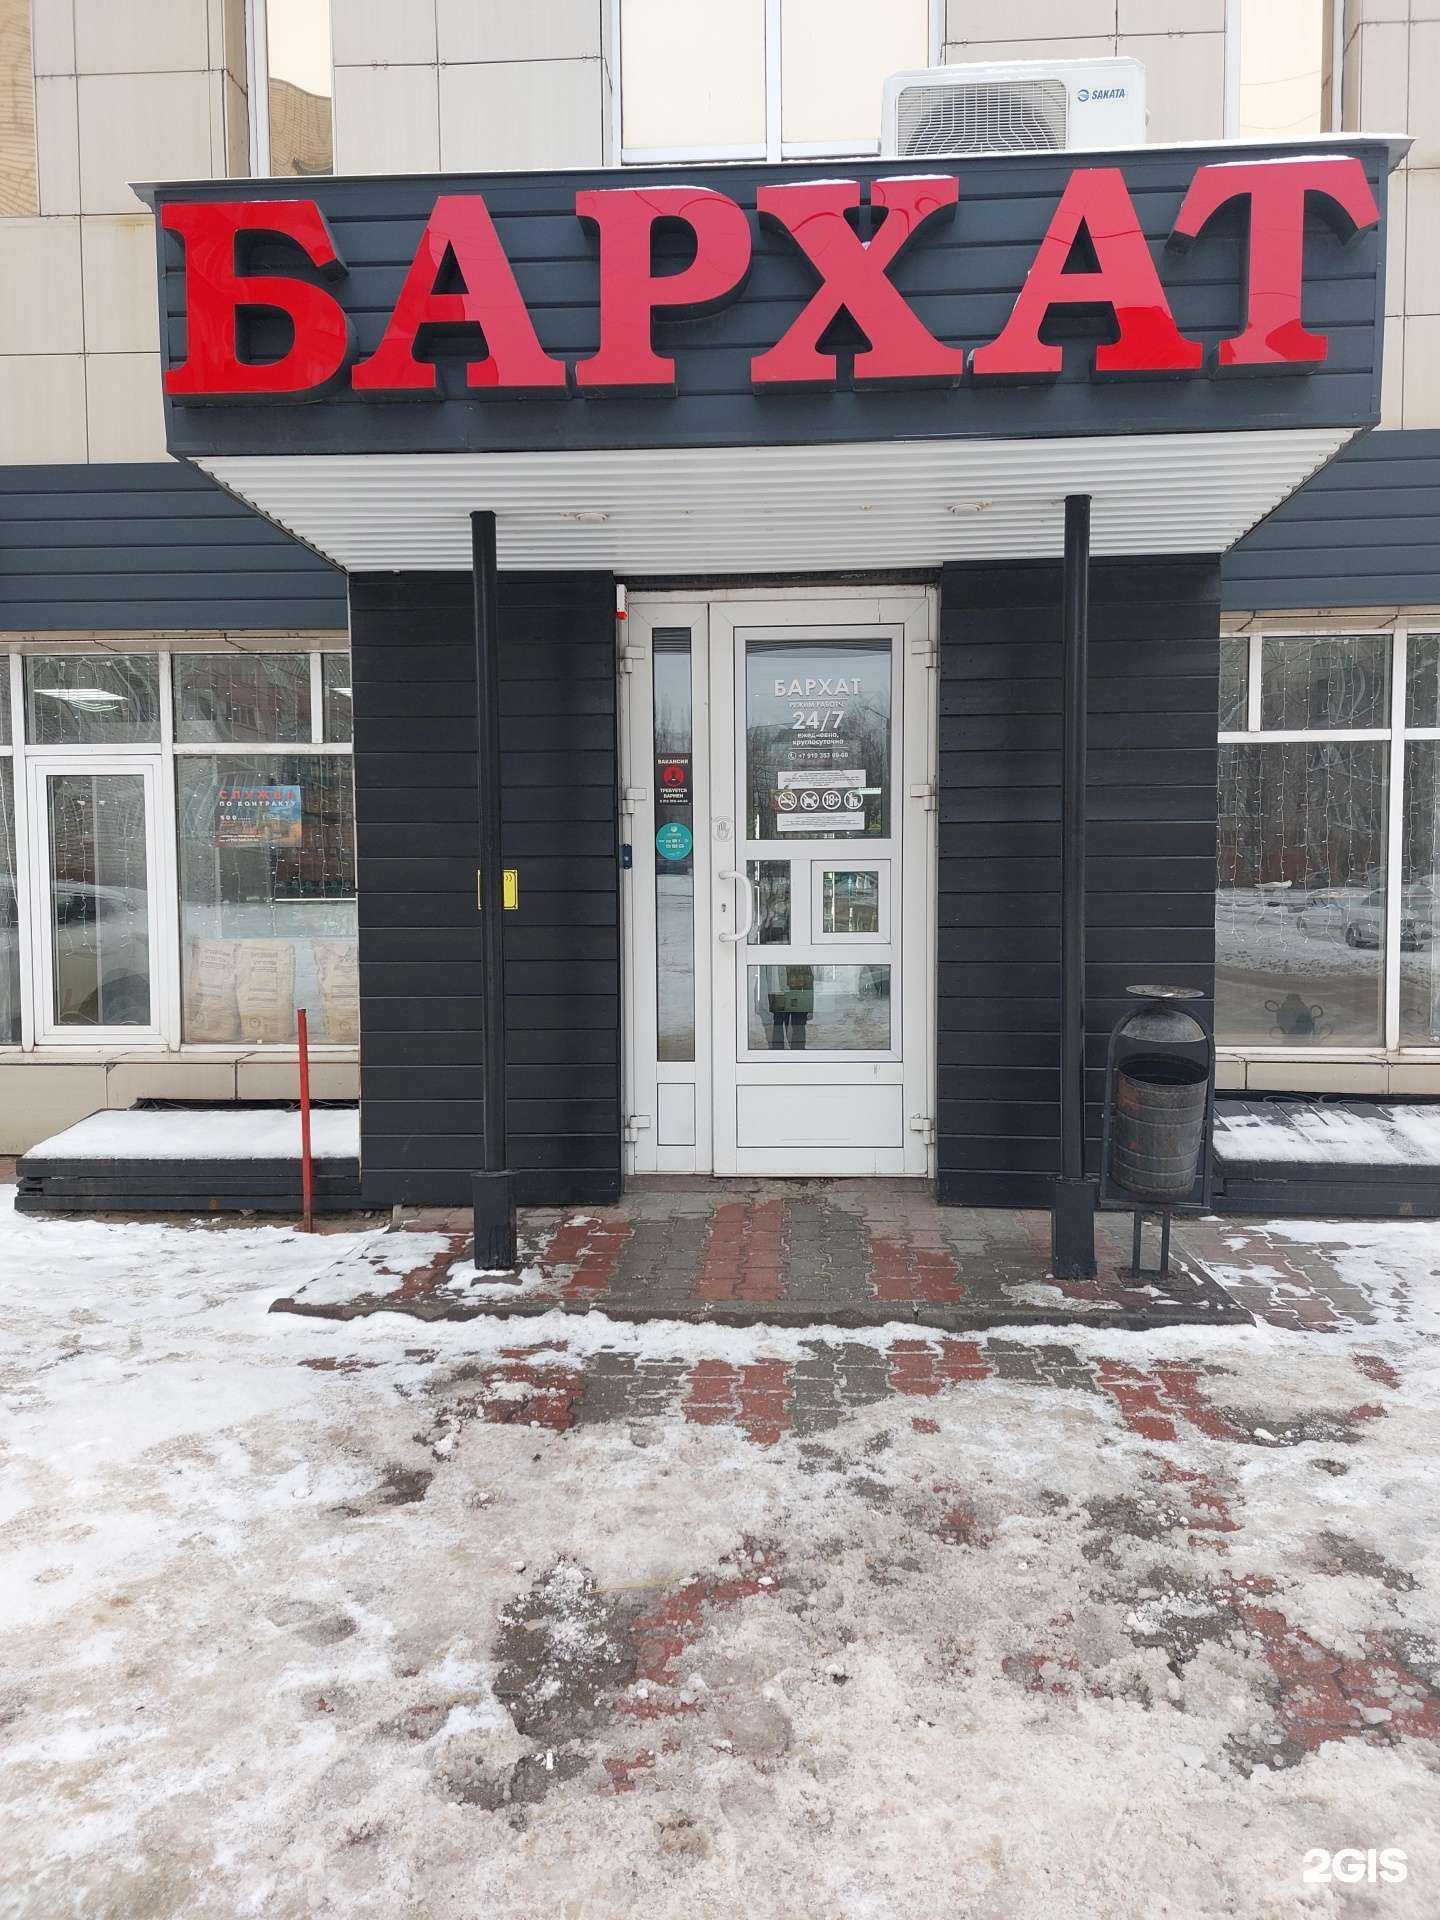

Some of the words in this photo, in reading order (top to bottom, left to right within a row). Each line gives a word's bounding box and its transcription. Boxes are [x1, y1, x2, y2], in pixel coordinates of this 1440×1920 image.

[1092, 88, 1125, 100] SAKATA
[161, 154, 1382, 398] БАРХАТ
[773, 677, 863, 698] БАРХАТ
[792, 710, 845, 732] 24/7
[825, 794, 840, 806] 18+
